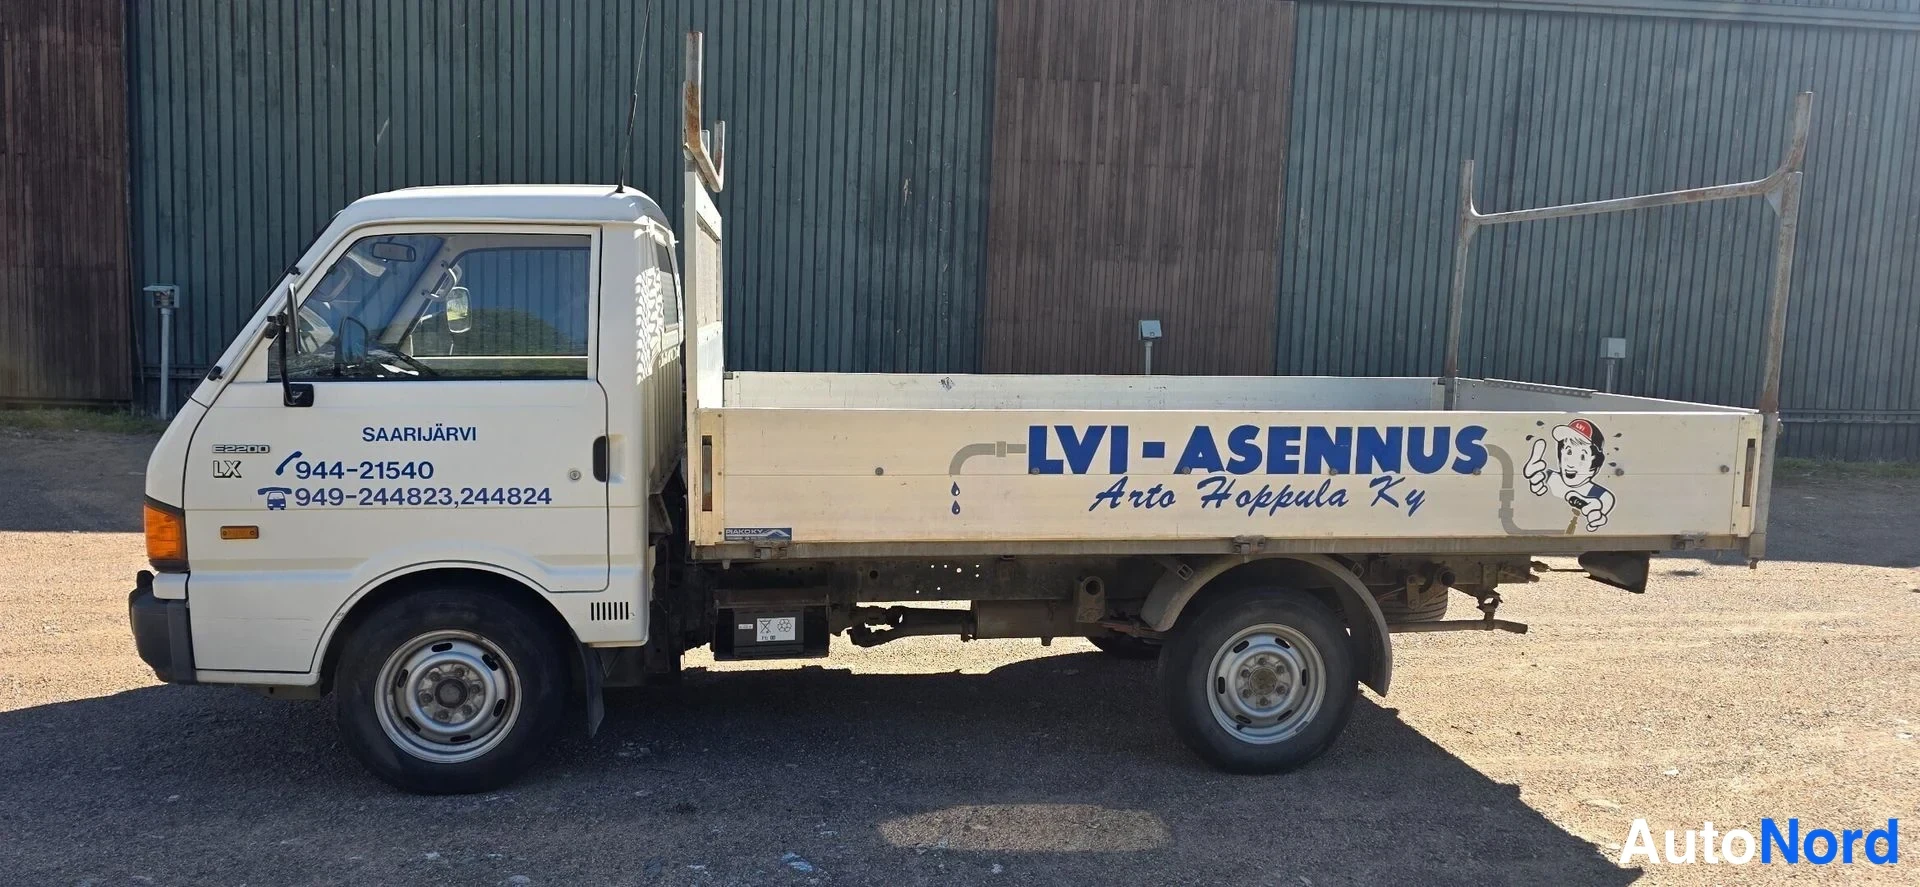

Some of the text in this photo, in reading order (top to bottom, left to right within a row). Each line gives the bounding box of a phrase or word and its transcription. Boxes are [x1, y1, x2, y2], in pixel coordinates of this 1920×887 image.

[361, 423, 477, 442] SAARIJÄRVI
[212, 444, 270, 454] E2200
[1028, 425, 1129, 475] LVI
[1173, 424, 1489, 475] ASENNUS
[213, 460, 241, 478] LX
[295, 461, 434, 480] 944-21540
[1088, 475, 1426, 517] Arto Hoppula Ky
